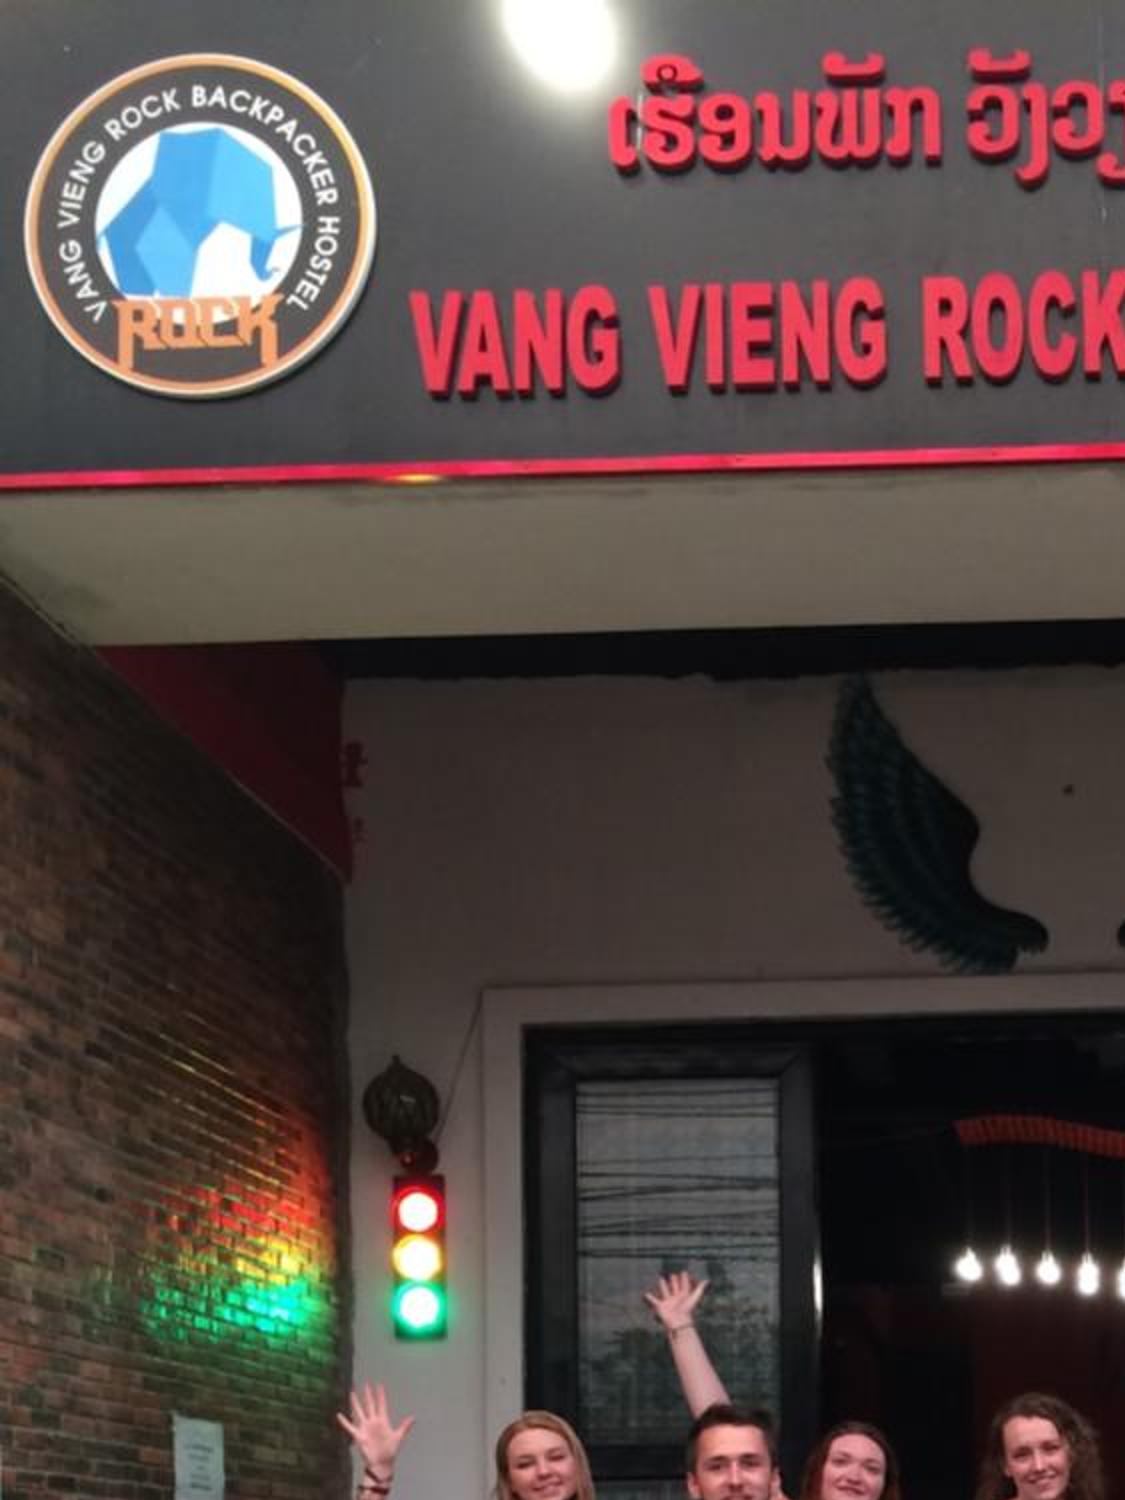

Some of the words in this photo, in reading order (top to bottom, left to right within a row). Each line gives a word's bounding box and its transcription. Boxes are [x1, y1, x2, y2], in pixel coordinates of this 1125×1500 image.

[105, 88, 182, 141] ROCK
[191, 85, 338, 207] BACKPACKER
[57, 143, 106, 229] VIENG
[59, 240, 106, 323] VANG
[286, 216, 340, 311] HOSTEL
[110, 293, 285, 369] ROCK
[410, 284, 617, 392] VANG
[649, 277, 886, 386] VIENG
